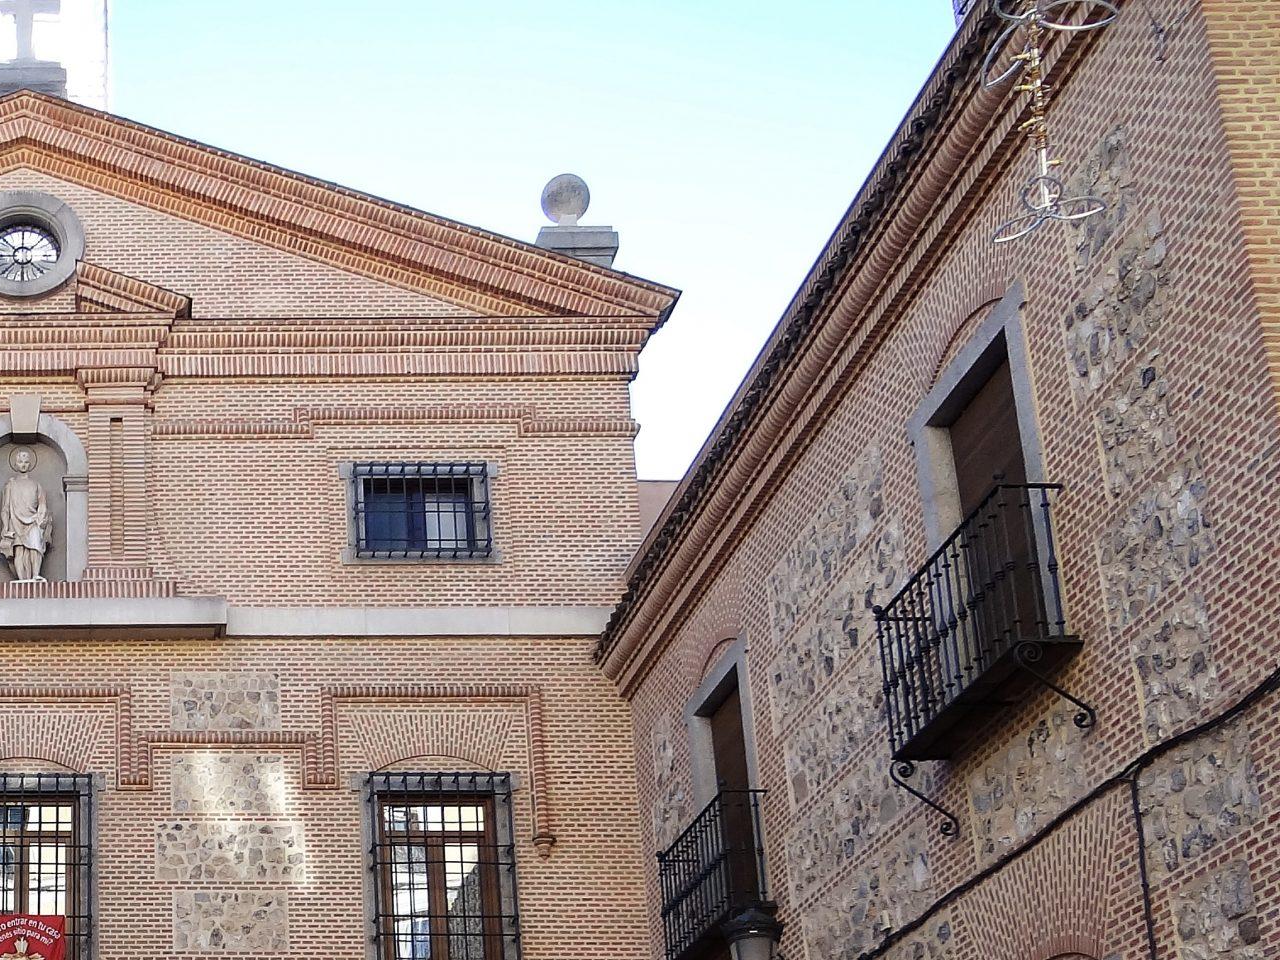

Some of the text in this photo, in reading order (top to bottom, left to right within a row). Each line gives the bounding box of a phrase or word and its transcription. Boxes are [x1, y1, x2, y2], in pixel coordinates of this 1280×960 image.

[6, 917, 28, 928] entrar
[28, 919, 38, 928] en
[38, 921, 46, 931] tu
[45, 926, 61, 939] casa
[12, 925, 26, 936] sitio
[26, 929, 40, 940] para
